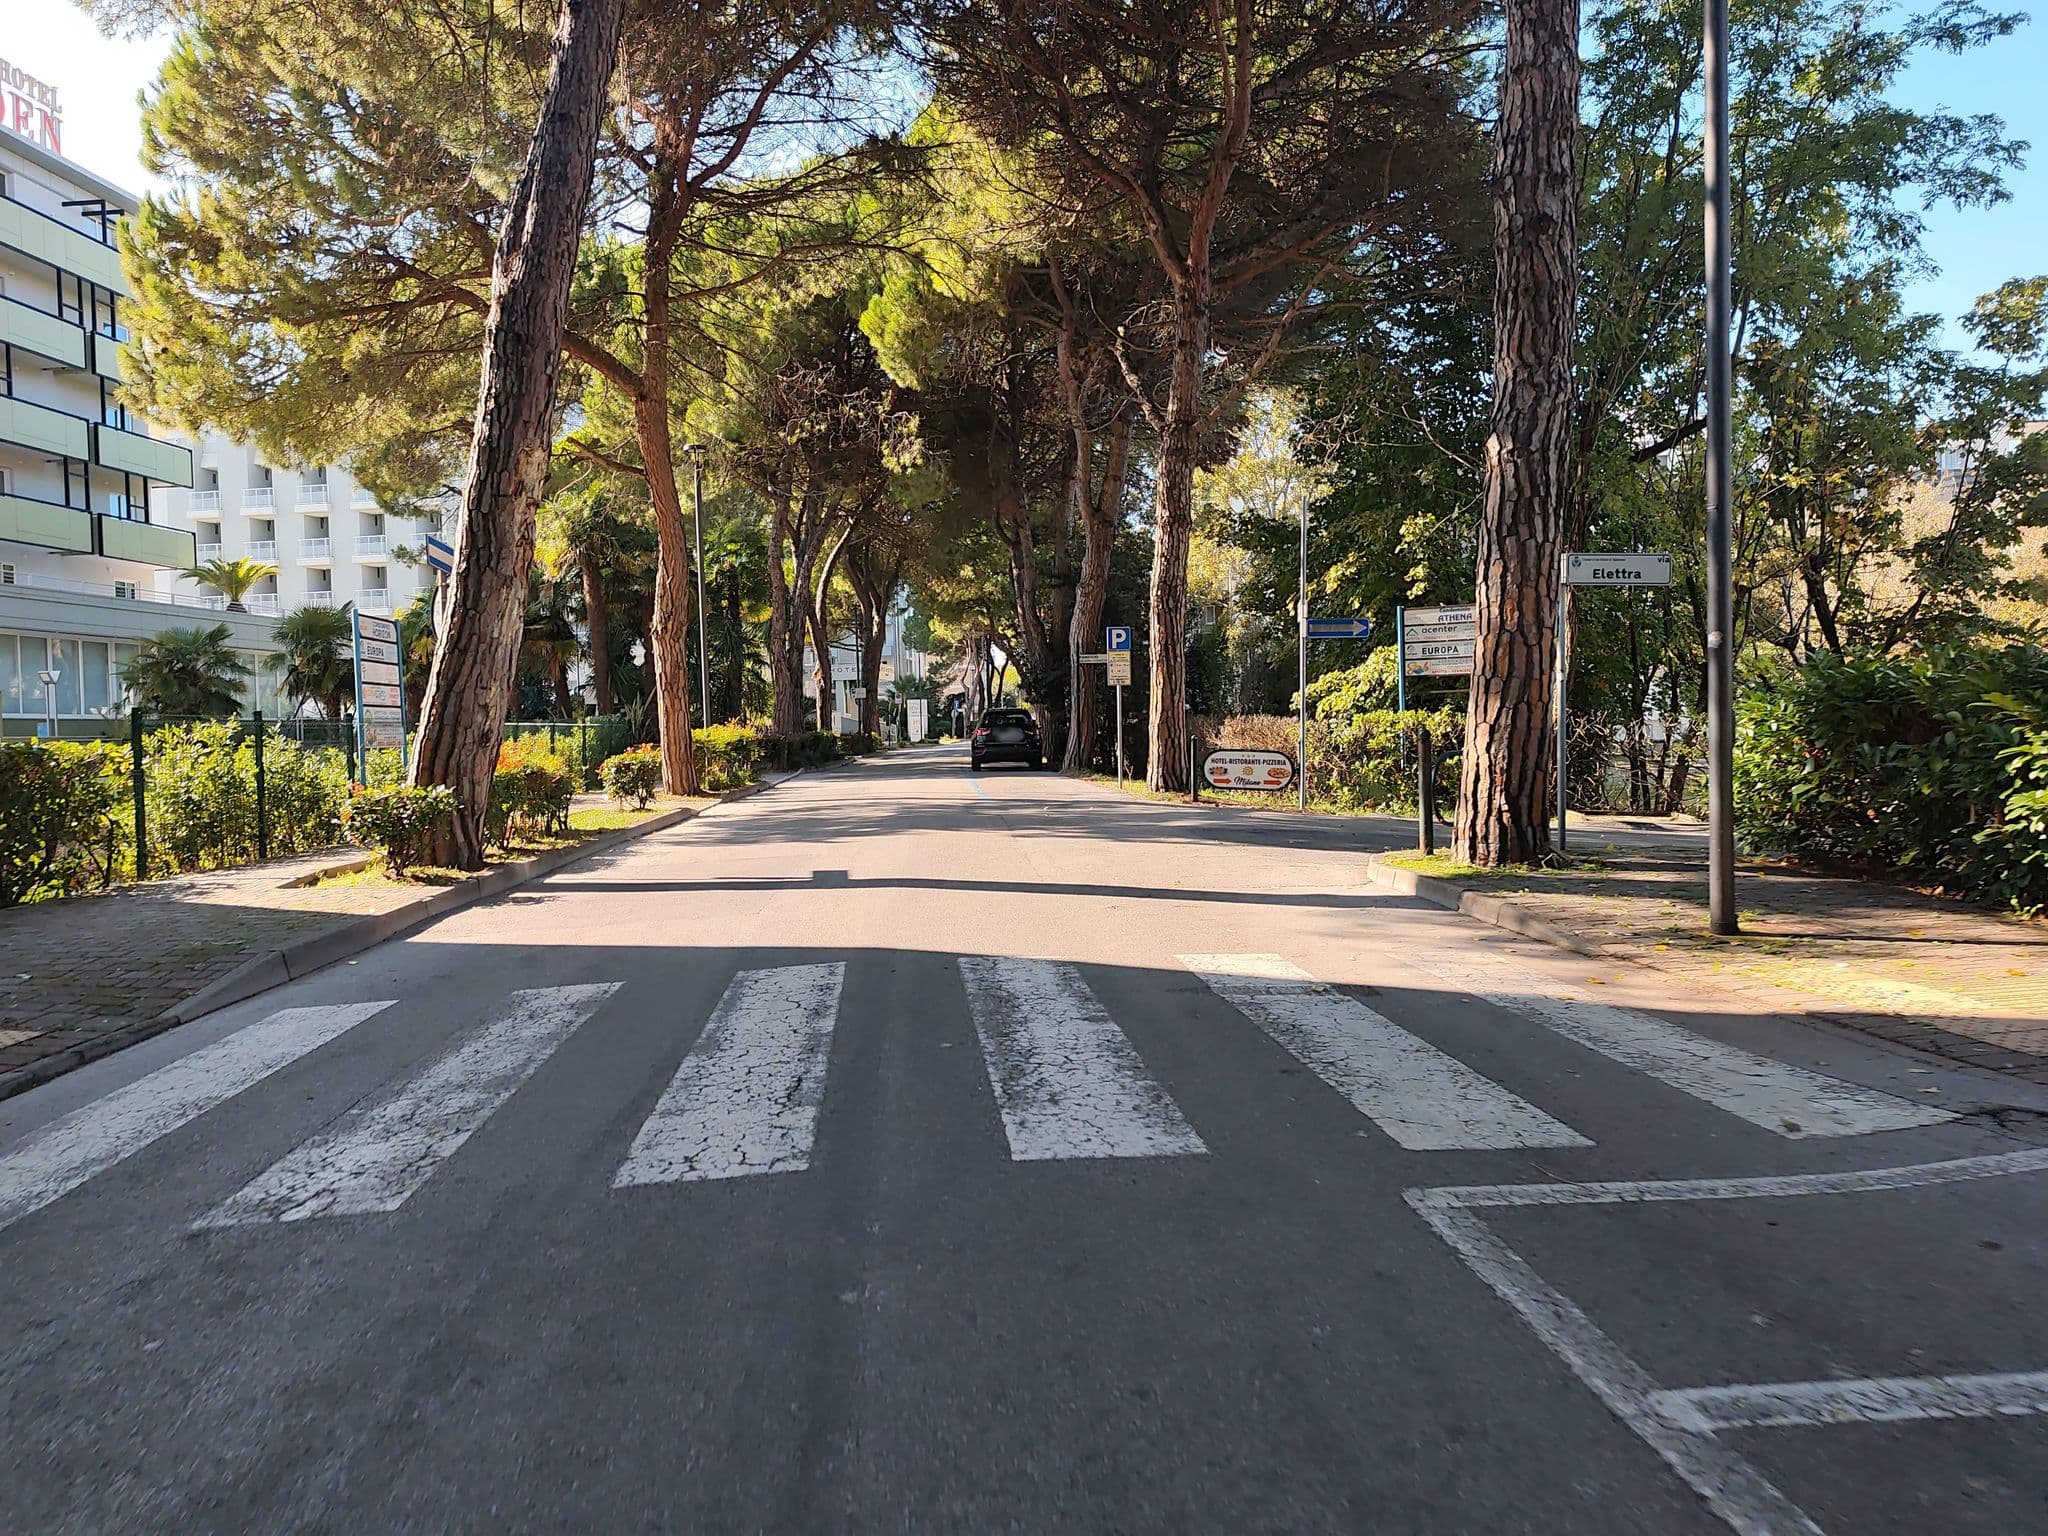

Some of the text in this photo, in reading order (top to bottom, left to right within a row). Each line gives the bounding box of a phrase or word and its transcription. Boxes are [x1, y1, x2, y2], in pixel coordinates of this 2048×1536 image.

[0, 58, 62, 113] HOTEL
[0, 91, 62, 156] EN
[1592, 568, 1642, 579] Elettra
[1438, 613, 1472, 622] ATHENA
[1421, 625, 1458, 634] acenter
[1111, 629, 1127, 649] P
[367, 645, 384, 657] EUROPA
[1421, 645, 1459, 655] EUROPA
[1233, 776, 1262, 787] Milano
